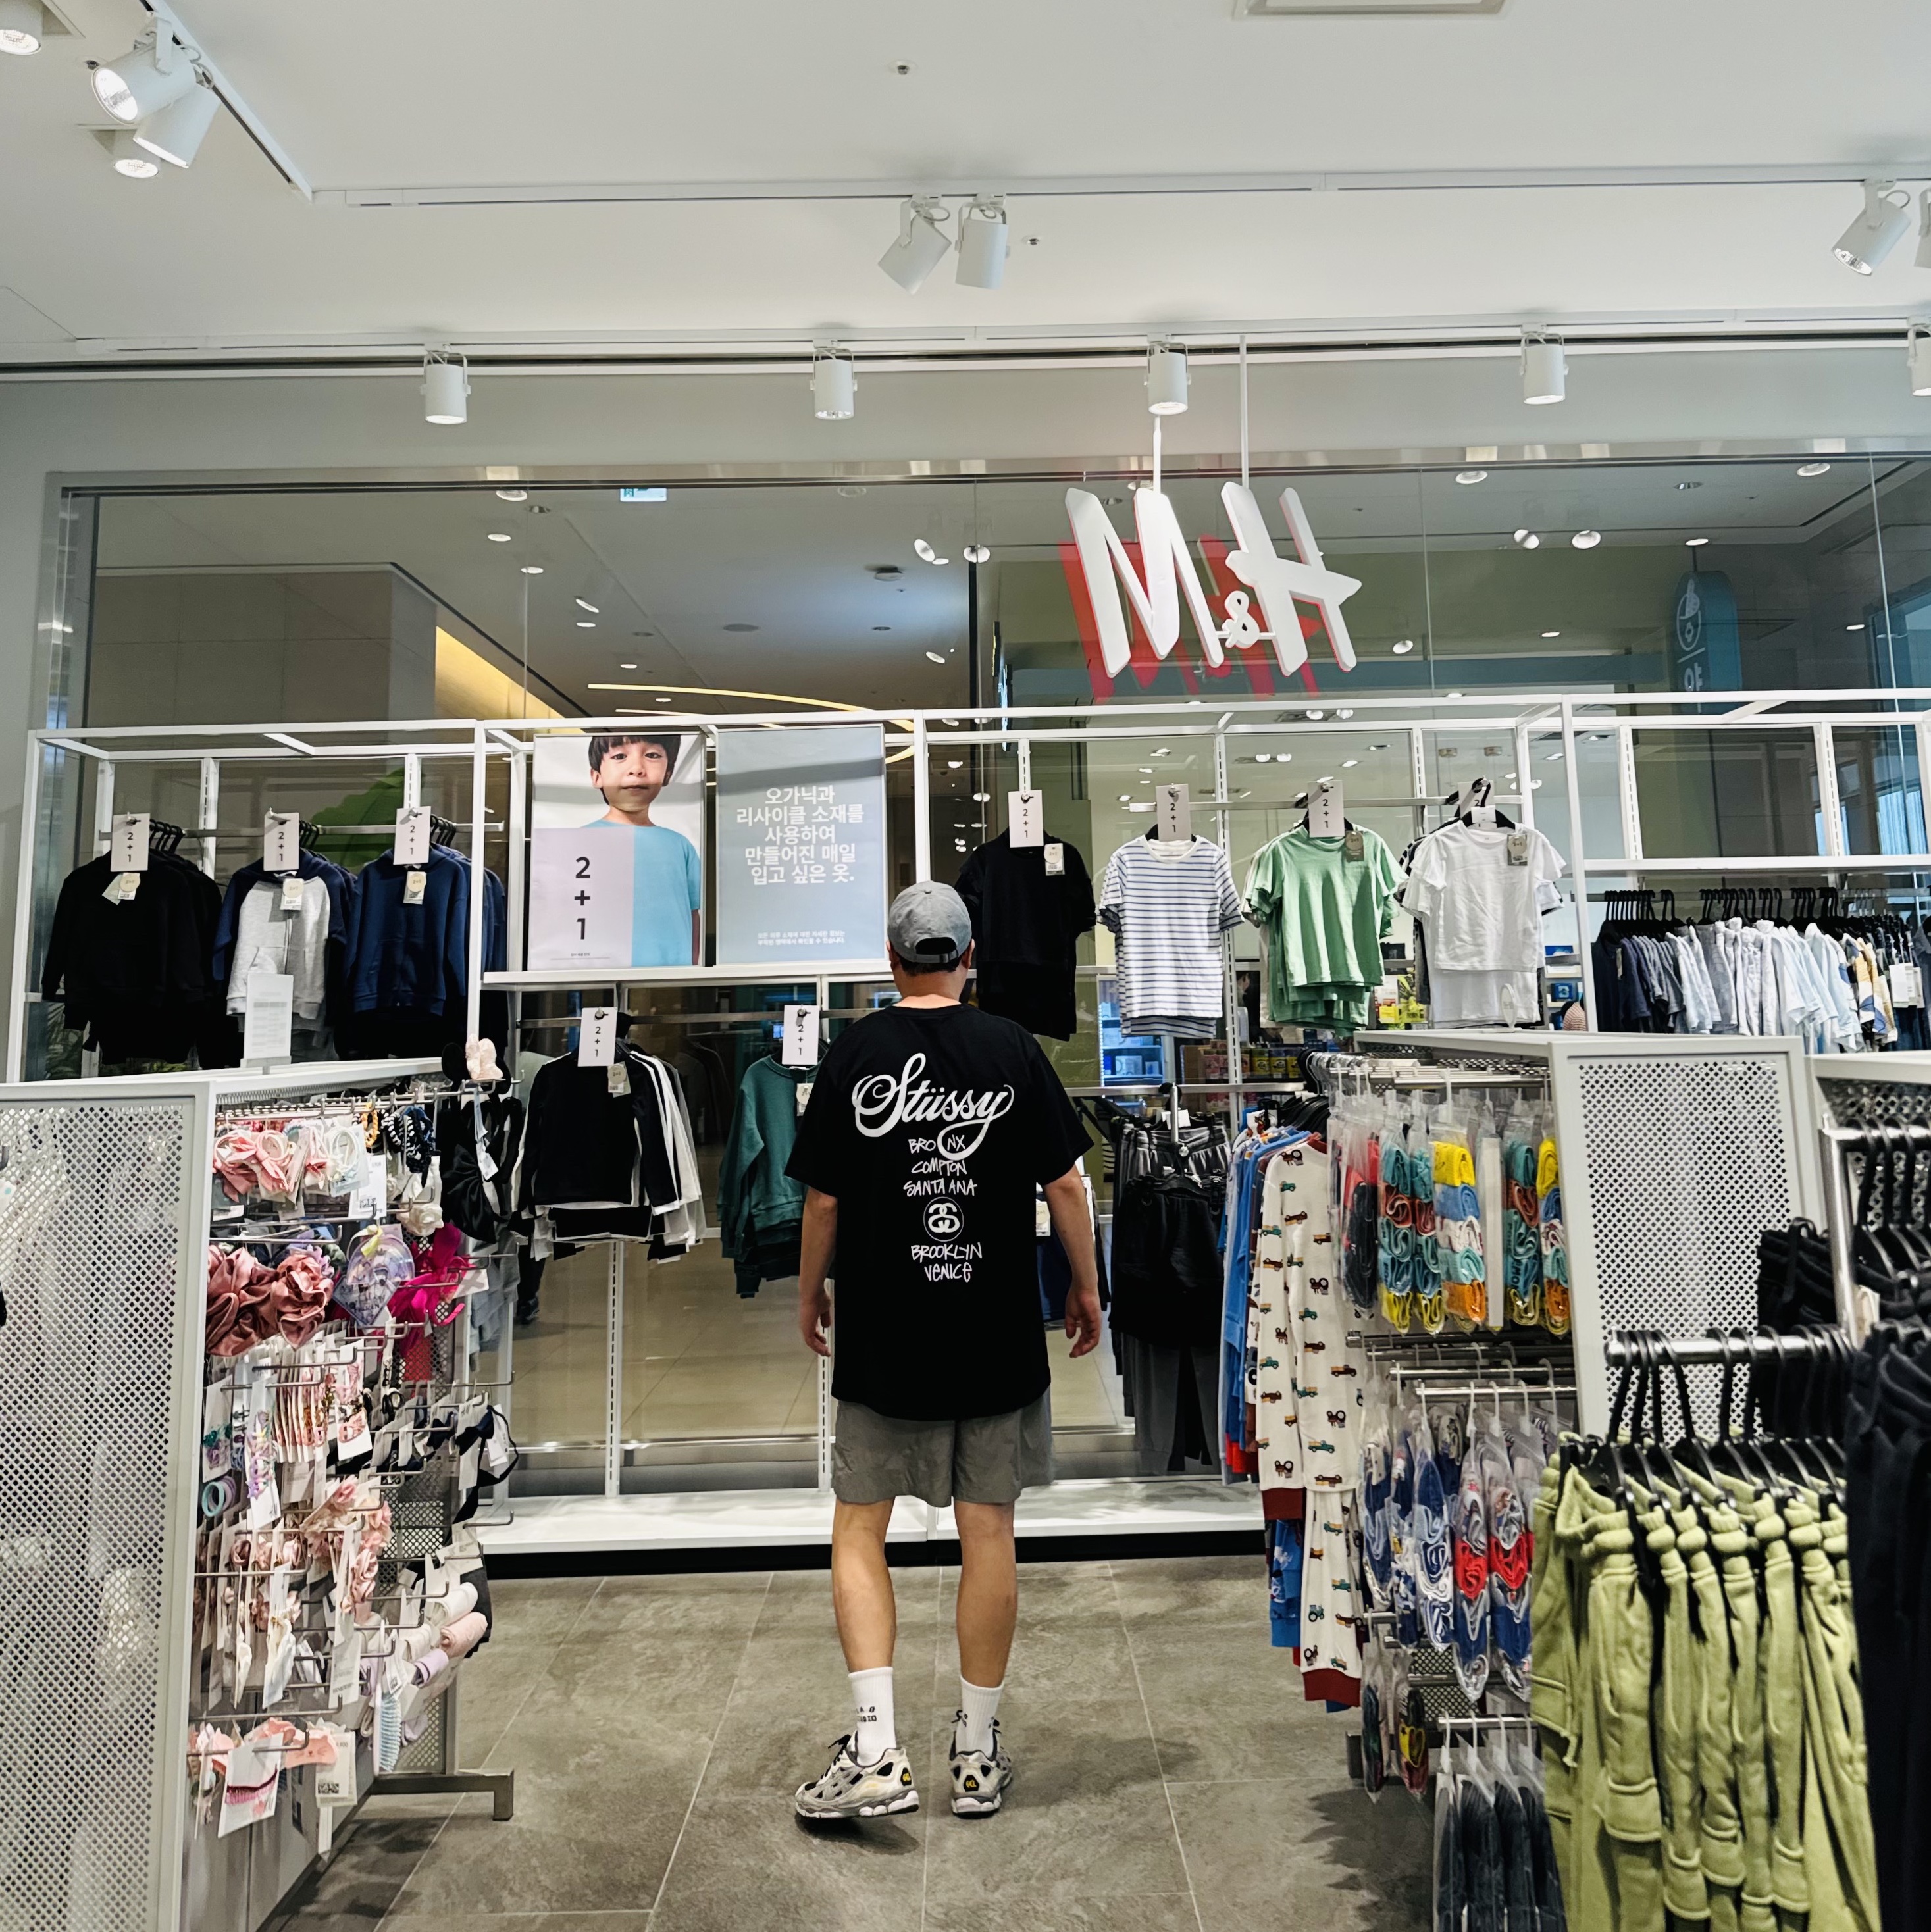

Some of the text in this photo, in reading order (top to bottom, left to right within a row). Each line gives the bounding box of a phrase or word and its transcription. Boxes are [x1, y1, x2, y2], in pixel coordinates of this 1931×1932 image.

[765, 785, 835, 805] 오가닉과
[736, 803, 865, 826] 리사이클 소재를
[765, 824, 835, 846] 사용하여
[745, 843, 856, 866] 만들어진 매일
[751, 863, 854, 886] 입고 싶은 옷.
[911, 1157, 967, 1176] COMPTON
[903, 1178, 977, 1197] SANTA ANA
[911, 1242, 983, 1263] BROOKLYN
